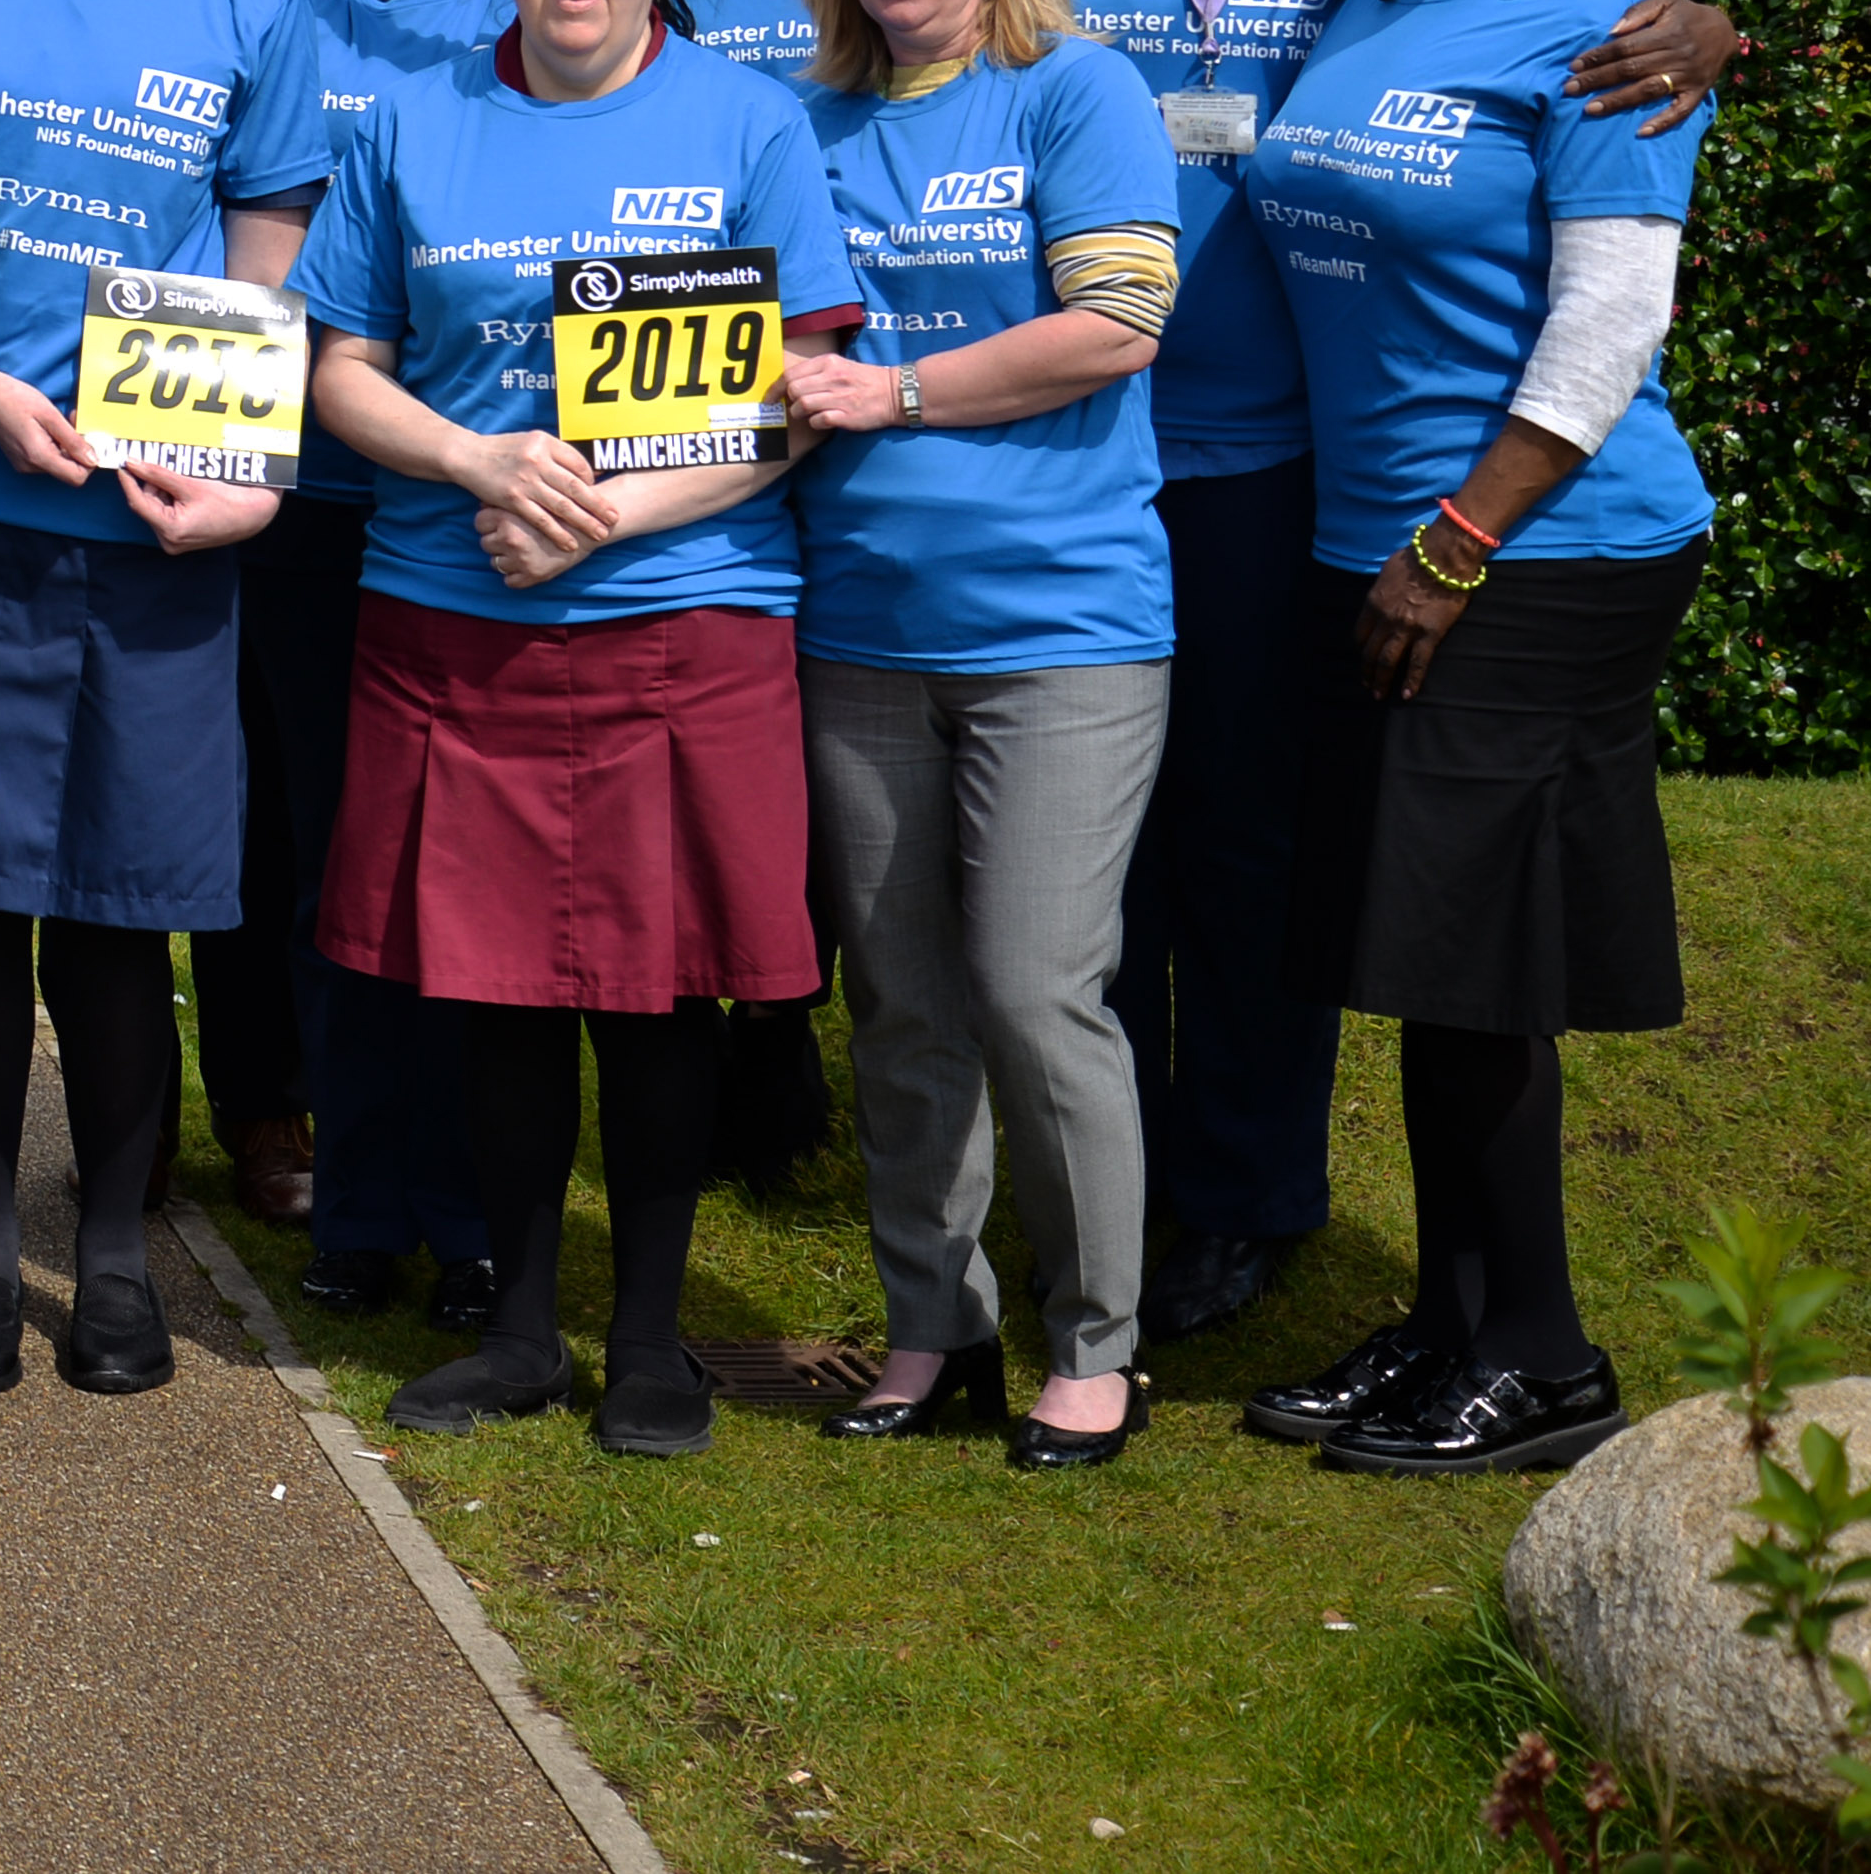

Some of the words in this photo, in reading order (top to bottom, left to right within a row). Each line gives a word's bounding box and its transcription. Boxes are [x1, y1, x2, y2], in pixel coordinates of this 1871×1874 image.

[693, 25, 770, 46] hester
[1073, 8, 1175, 32] chester
[727, 47, 761, 63] NHS
[1127, 37, 1165, 53] NHS
[1287, 45, 1309, 60] Tru
[140, 74, 230, 124] NHS
[1372, 93, 1472, 132] NHS
[35, 126, 72, 146] NHS
[75, 132, 177, 171] Foundation
[92, 106, 214, 161] University
[1333, 127, 1460, 170] University
[1290, 149, 1317, 167] NHS
[1318, 152, 1395, 181] Foundation
[1401, 167, 1453, 188] Trust
[926, 170, 1020, 209] NHS
[617, 191, 718, 223] NHS
[1259, 198, 1376, 240] Ryman
[889, 216, 1023, 245] University
[411, 235, 563, 271] Manchester
[515, 261, 553, 279] NHS
[877, 248, 975, 268] Foundation
[979, 245, 1029, 264] Trust
[1288, 250, 1367, 283] #TeamMFT
[629, 267, 762, 294] Simplyhealth
[863, 309, 968, 332] man
[582, 310, 765, 405] 2019
[593, 429, 758, 471] MANCHESTER
